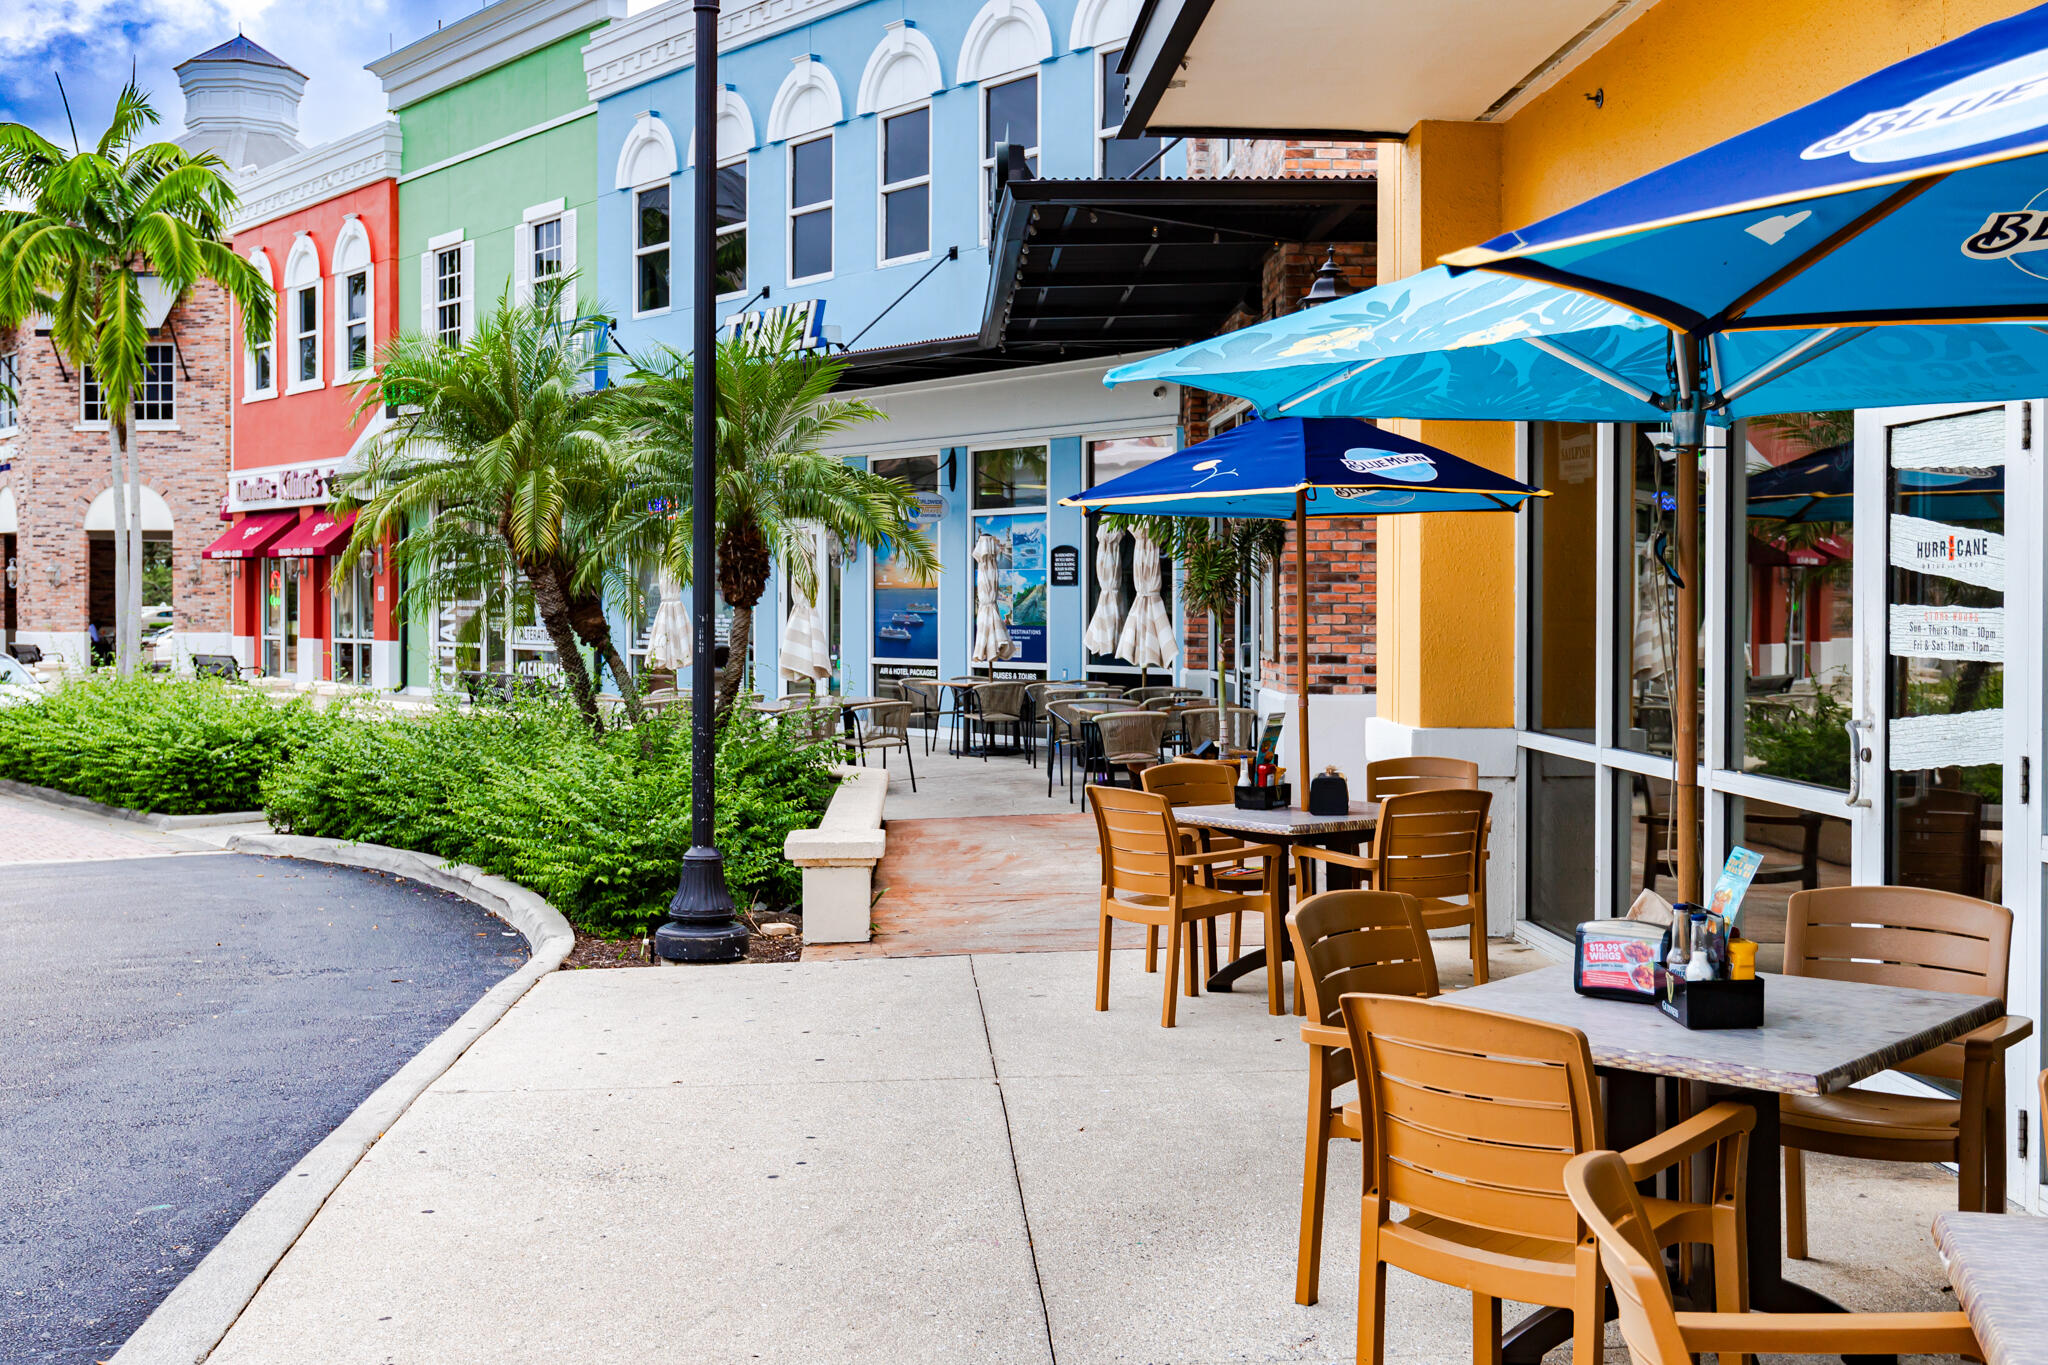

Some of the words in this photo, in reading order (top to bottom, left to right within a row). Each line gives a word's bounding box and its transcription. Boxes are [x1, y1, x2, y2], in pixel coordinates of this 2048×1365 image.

[725, 299, 821, 358] TRAVEL
[1345, 458, 1389, 472] BLUE
[1386, 455, 1429, 467] MOON
[1917, 535, 1988, 560] HURRICANE
[1977, 627, 1996, 640] 10pm
[880, 667, 889, 675] AIR
[893, 667, 909, 676] HOTEL
[910, 668, 936, 677] PACKAGES
[993, 671, 1012, 680] RUISES
[1018, 672, 1037, 681] TOURS
[1589, 952, 1621, 960] WINGS
